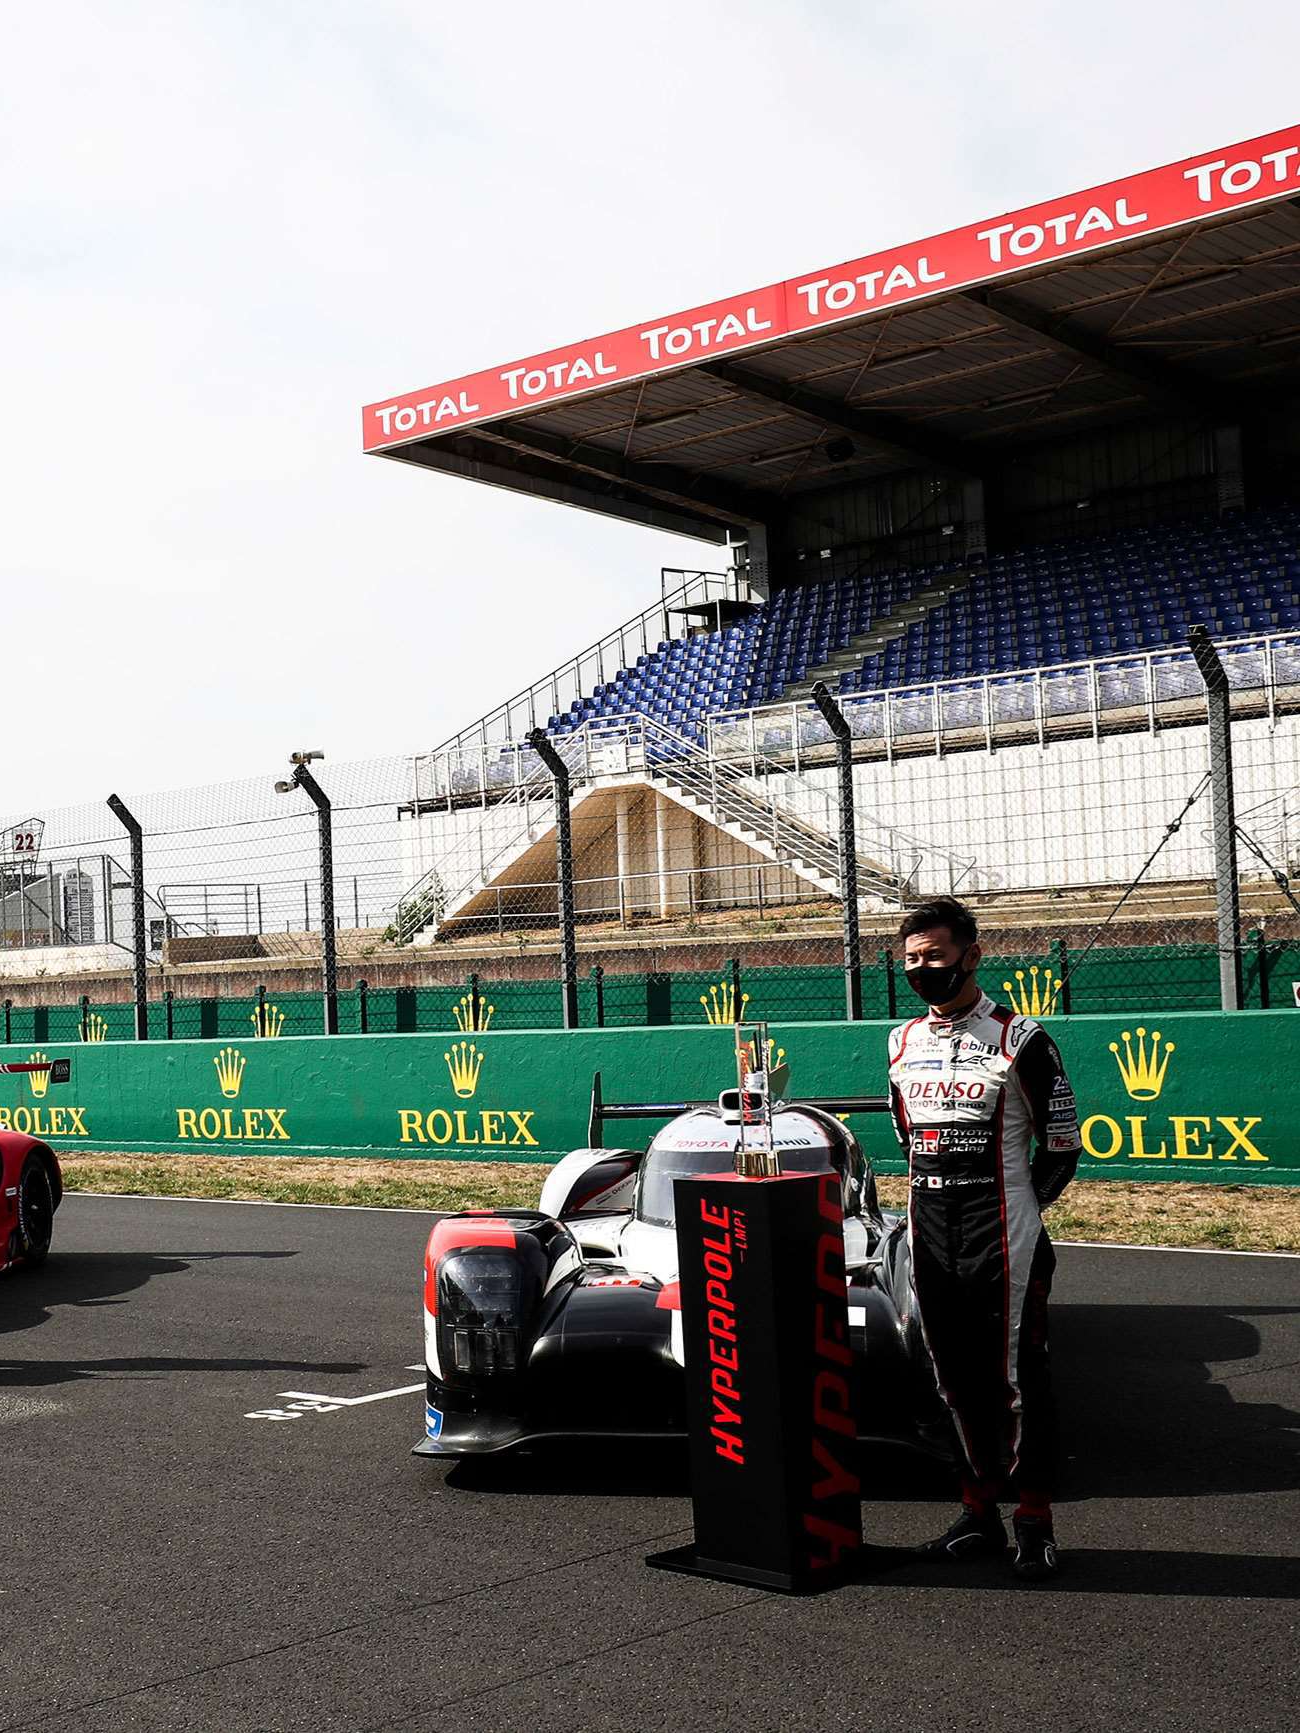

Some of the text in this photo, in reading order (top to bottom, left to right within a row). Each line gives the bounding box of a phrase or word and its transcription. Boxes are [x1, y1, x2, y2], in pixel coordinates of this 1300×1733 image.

[1183, 146, 1300, 203] TOT
[976, 197, 1148, 263] TOTAL
[796, 255, 946, 315] TOTAL
[640, 306, 772, 358] TOTAL
[500, 351, 617, 400] TOTAL
[374, 389, 480, 437] TOTAL
[15, 832, 34, 851] 22
[908, 1081, 986, 1100] DENSO
[908, 1100, 939, 1109] TOYOTA
[176, 1107, 291, 1140] ROLEX
[397, 1109, 540, 1146] ROLEX
[941, 1128, 994, 1137] TOYOTA
[1080, 1114, 1270, 1162] OLEX
[674, 1141, 729, 1149] TOYOTA
[913, 1138, 939, 1153] GR
[701, 1198, 745, 1465] HYPERPOLE
